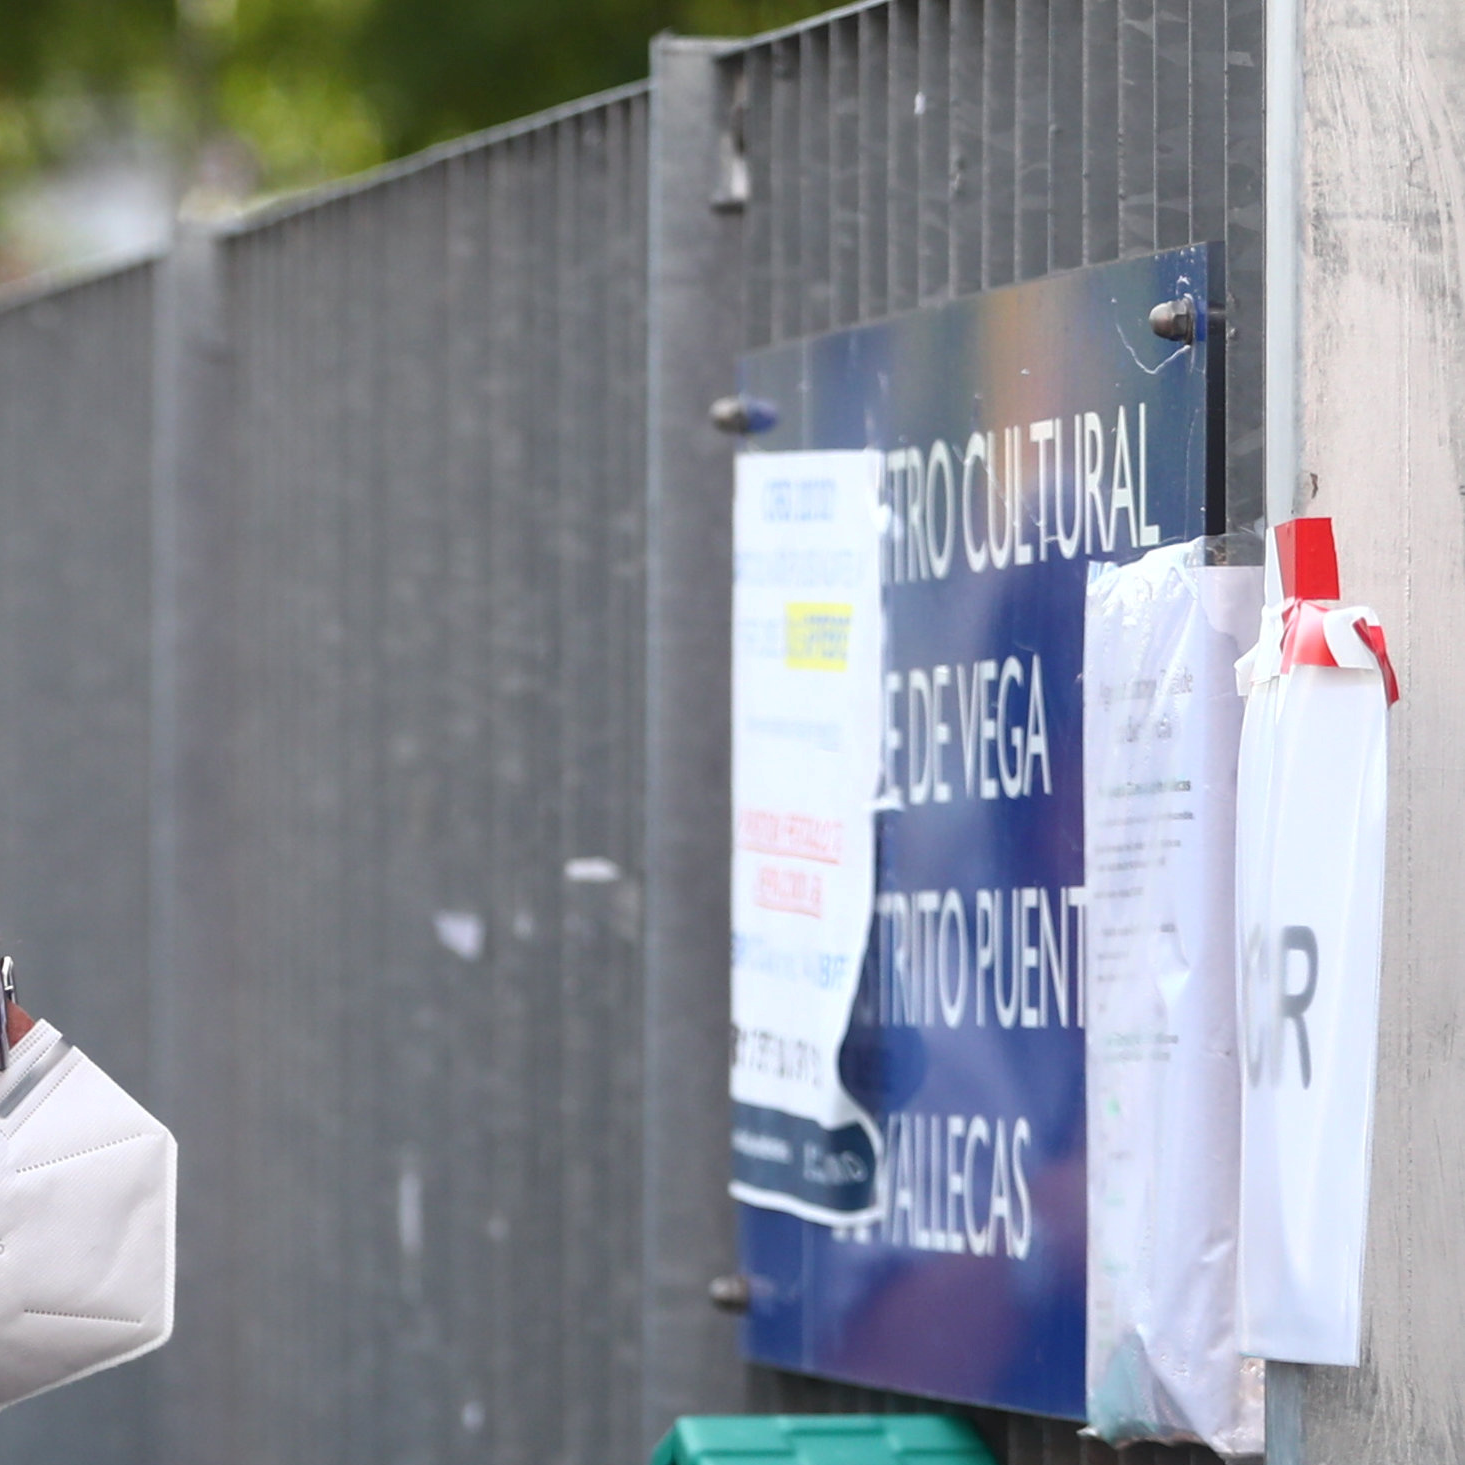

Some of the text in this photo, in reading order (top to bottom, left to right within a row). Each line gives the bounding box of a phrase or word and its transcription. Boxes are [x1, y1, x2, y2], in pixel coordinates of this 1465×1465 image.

[962, 402, 1160, 574] CULTURAL
[908, 664, 951, 806] DE
[957, 653, 1053, 800] VEGA
[876, 888, 969, 1030] TRITO
[976, 887, 1087, 1030] PUENT
